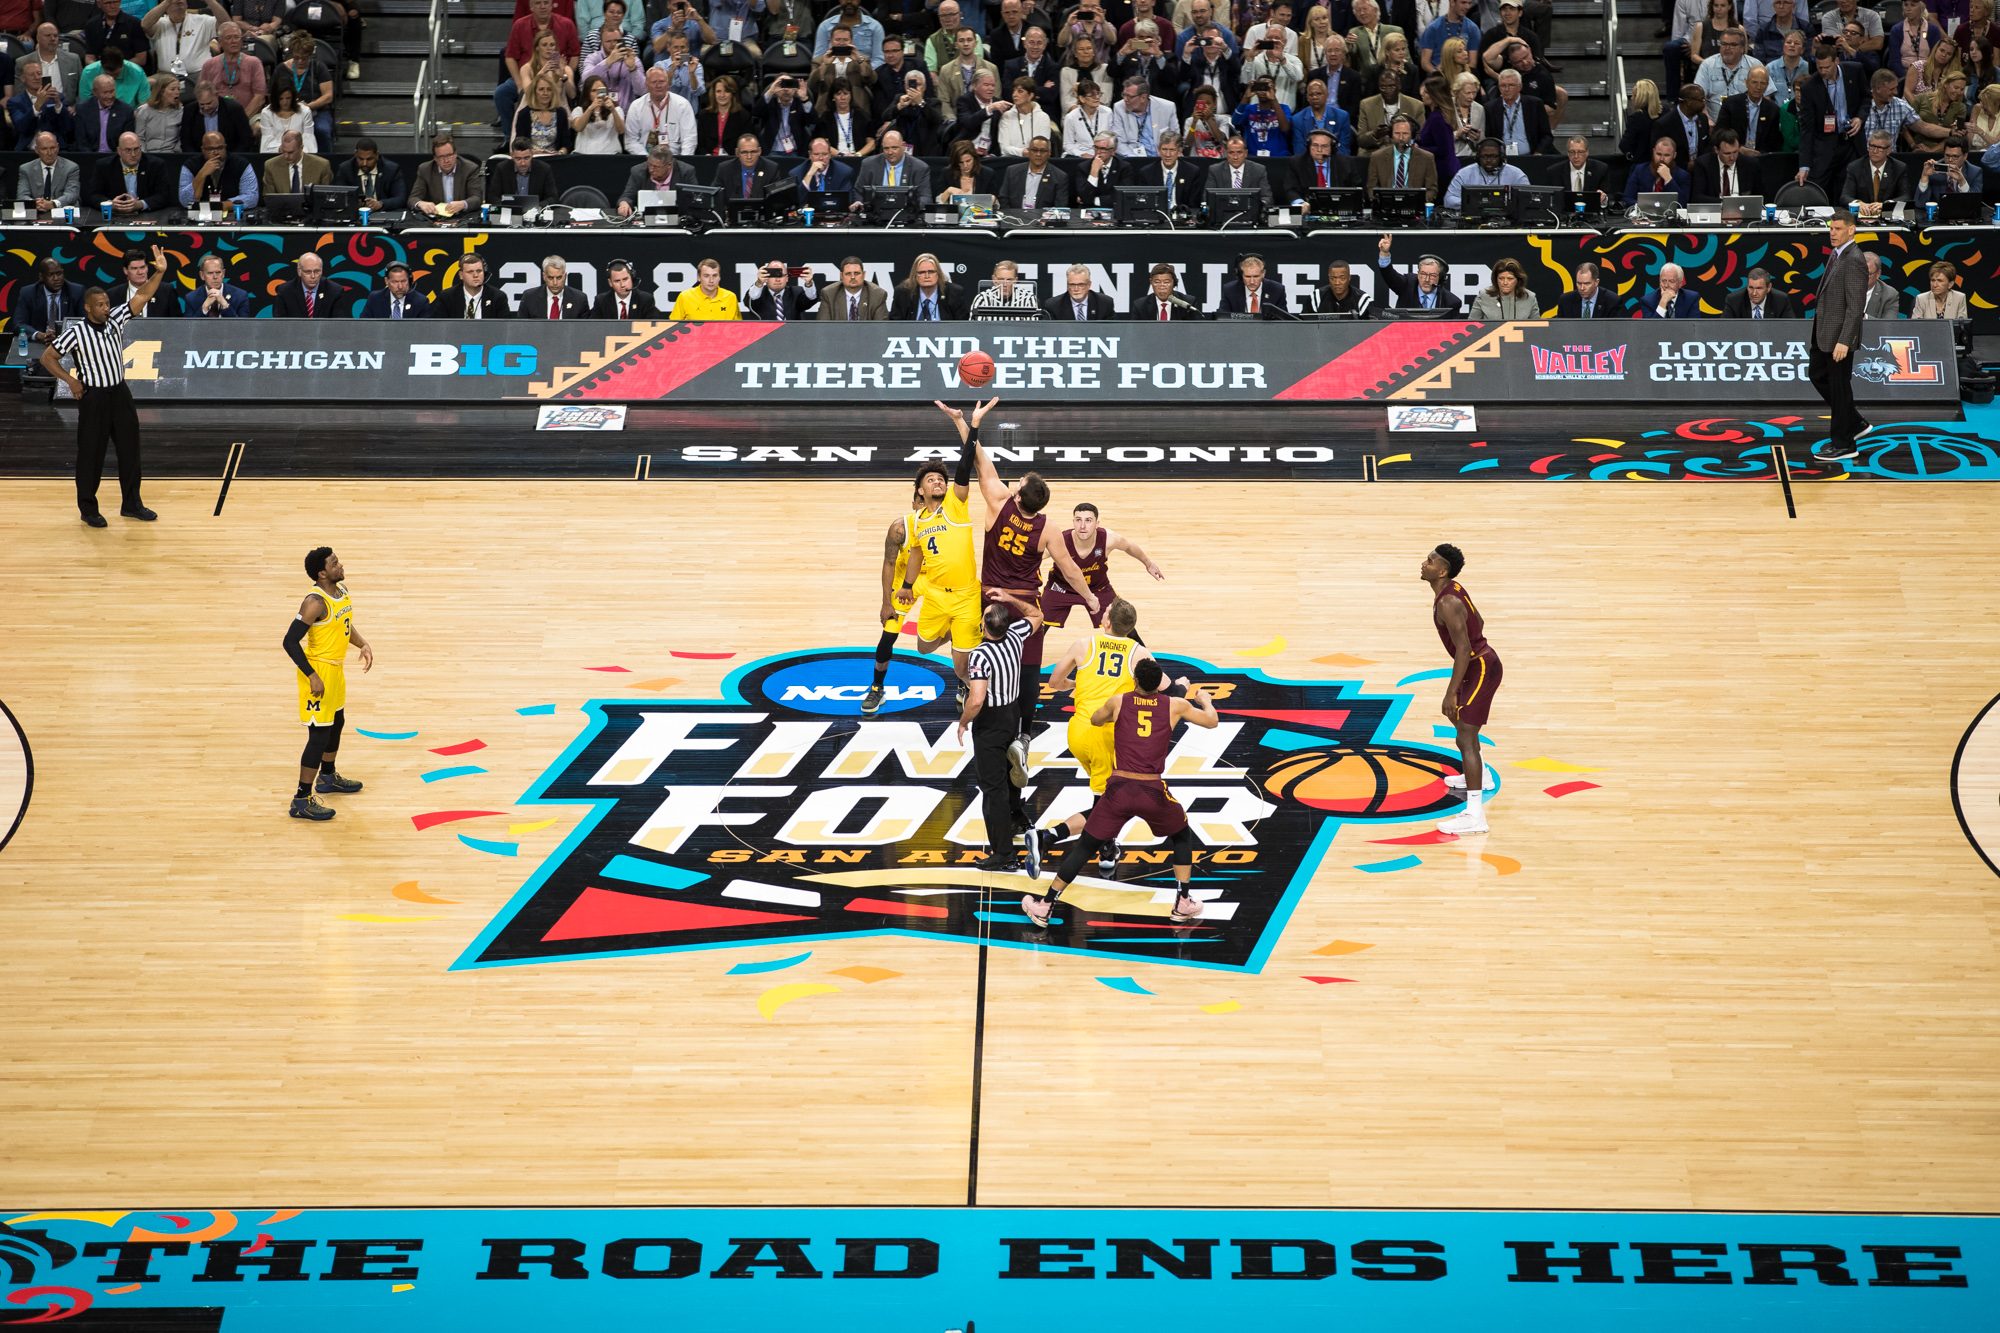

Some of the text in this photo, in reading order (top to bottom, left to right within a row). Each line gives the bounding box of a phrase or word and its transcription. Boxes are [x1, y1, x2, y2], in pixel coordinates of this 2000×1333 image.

[882, 337, 1120, 358] AND THEN
[1562, 344, 1593, 352] THE
[1658, 342, 1810, 360] LOYOLA
[183, 350, 385, 369] MICHIGAN
[1531, 344, 1627, 374] VALLEY
[735, 363, 921, 388] THERE
[1117, 363, 1267, 388] FOUR
[682, 446, 1334, 462] SAN ANTONIO
[927, 536, 939, 555] 4
[998, 526, 1029, 556] 25
[344, 617, 350, 637] 3
[1100, 641, 1128, 652] WAGNER
[1097, 651, 1124, 678] 13
[306, 700, 321, 711] M
[1133, 696, 1158, 707] TOWNES
[1137, 710, 1152, 737] 5
[707, 850, 872, 864] SAN
[81, 1238, 1969, 1288] THE ROAD ENDS HERE
